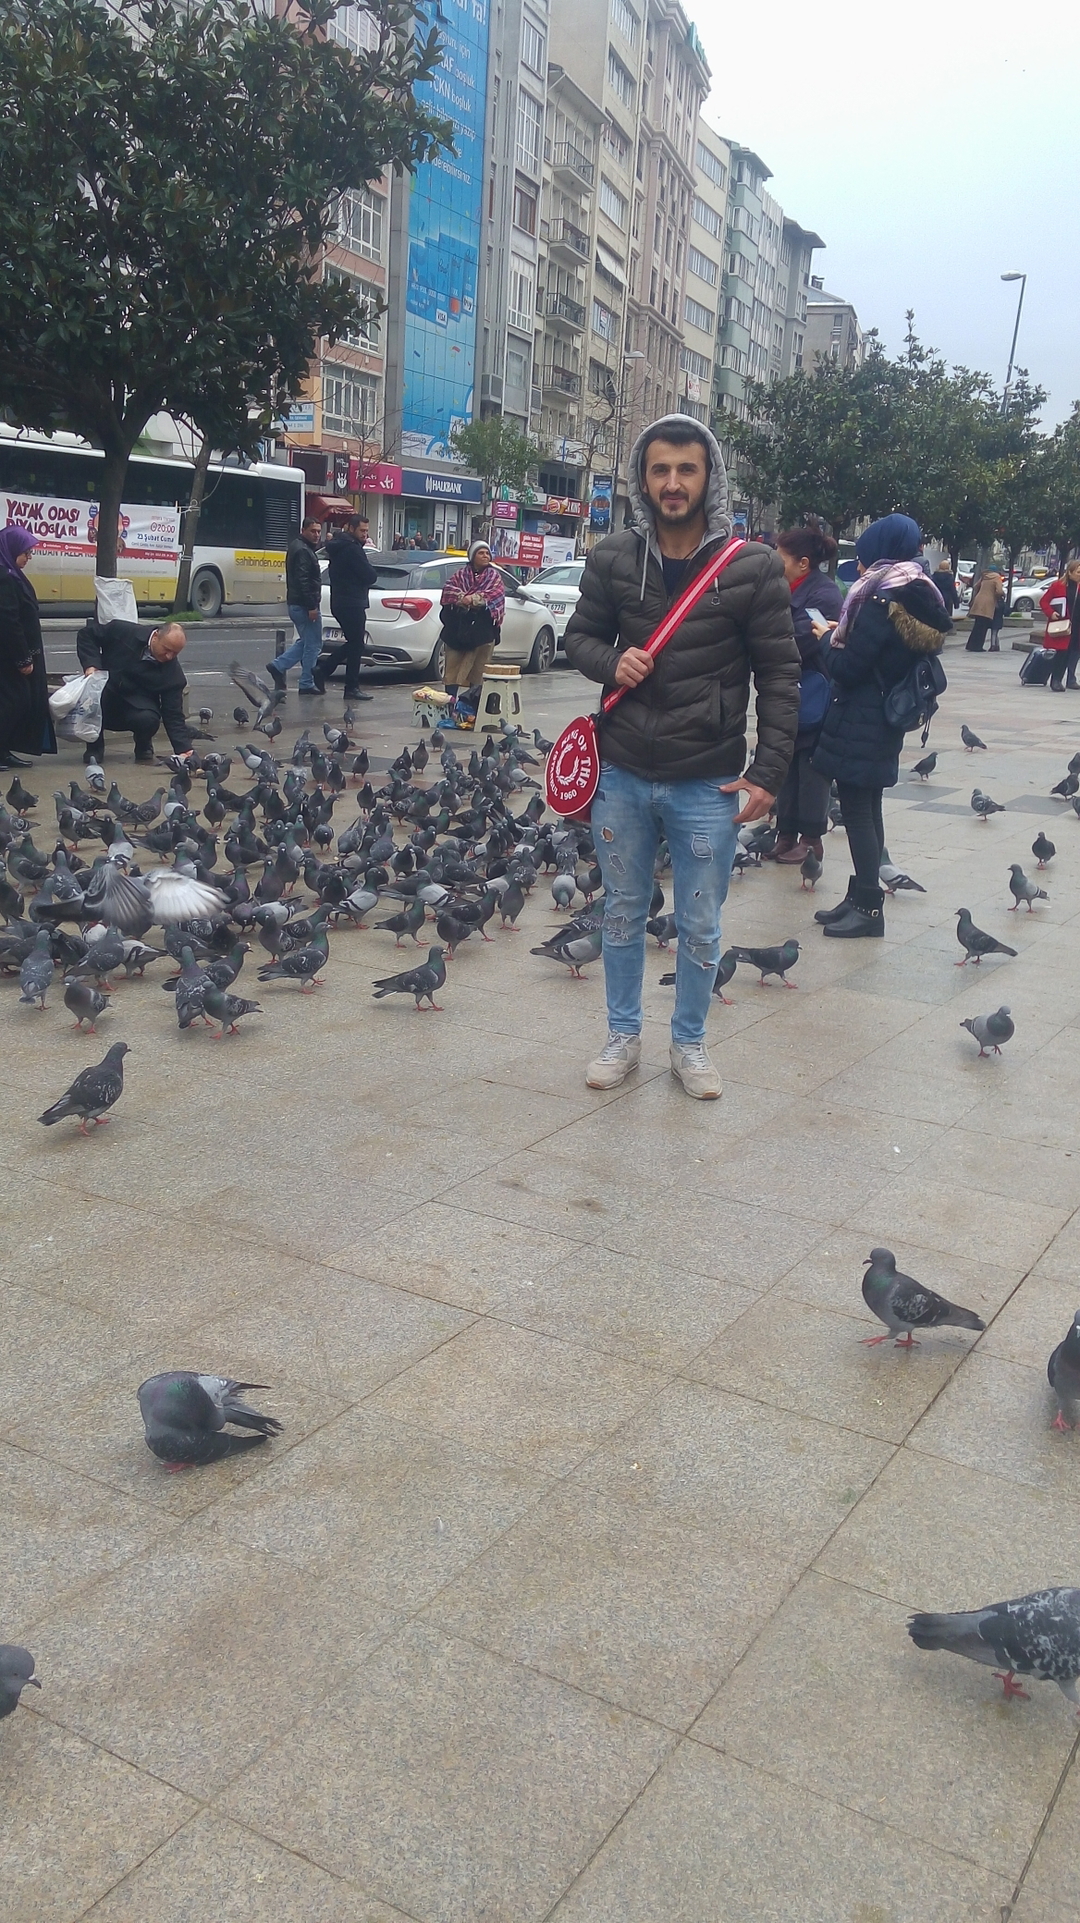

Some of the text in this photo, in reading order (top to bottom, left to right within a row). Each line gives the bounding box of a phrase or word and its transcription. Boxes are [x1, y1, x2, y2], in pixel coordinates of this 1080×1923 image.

[432, 479, 462, 494] HALKBANK
[6, 498, 81, 523] YATAK ODASI
[578, 735, 588, 751] OF
[576, 757, 591, 788] THE
